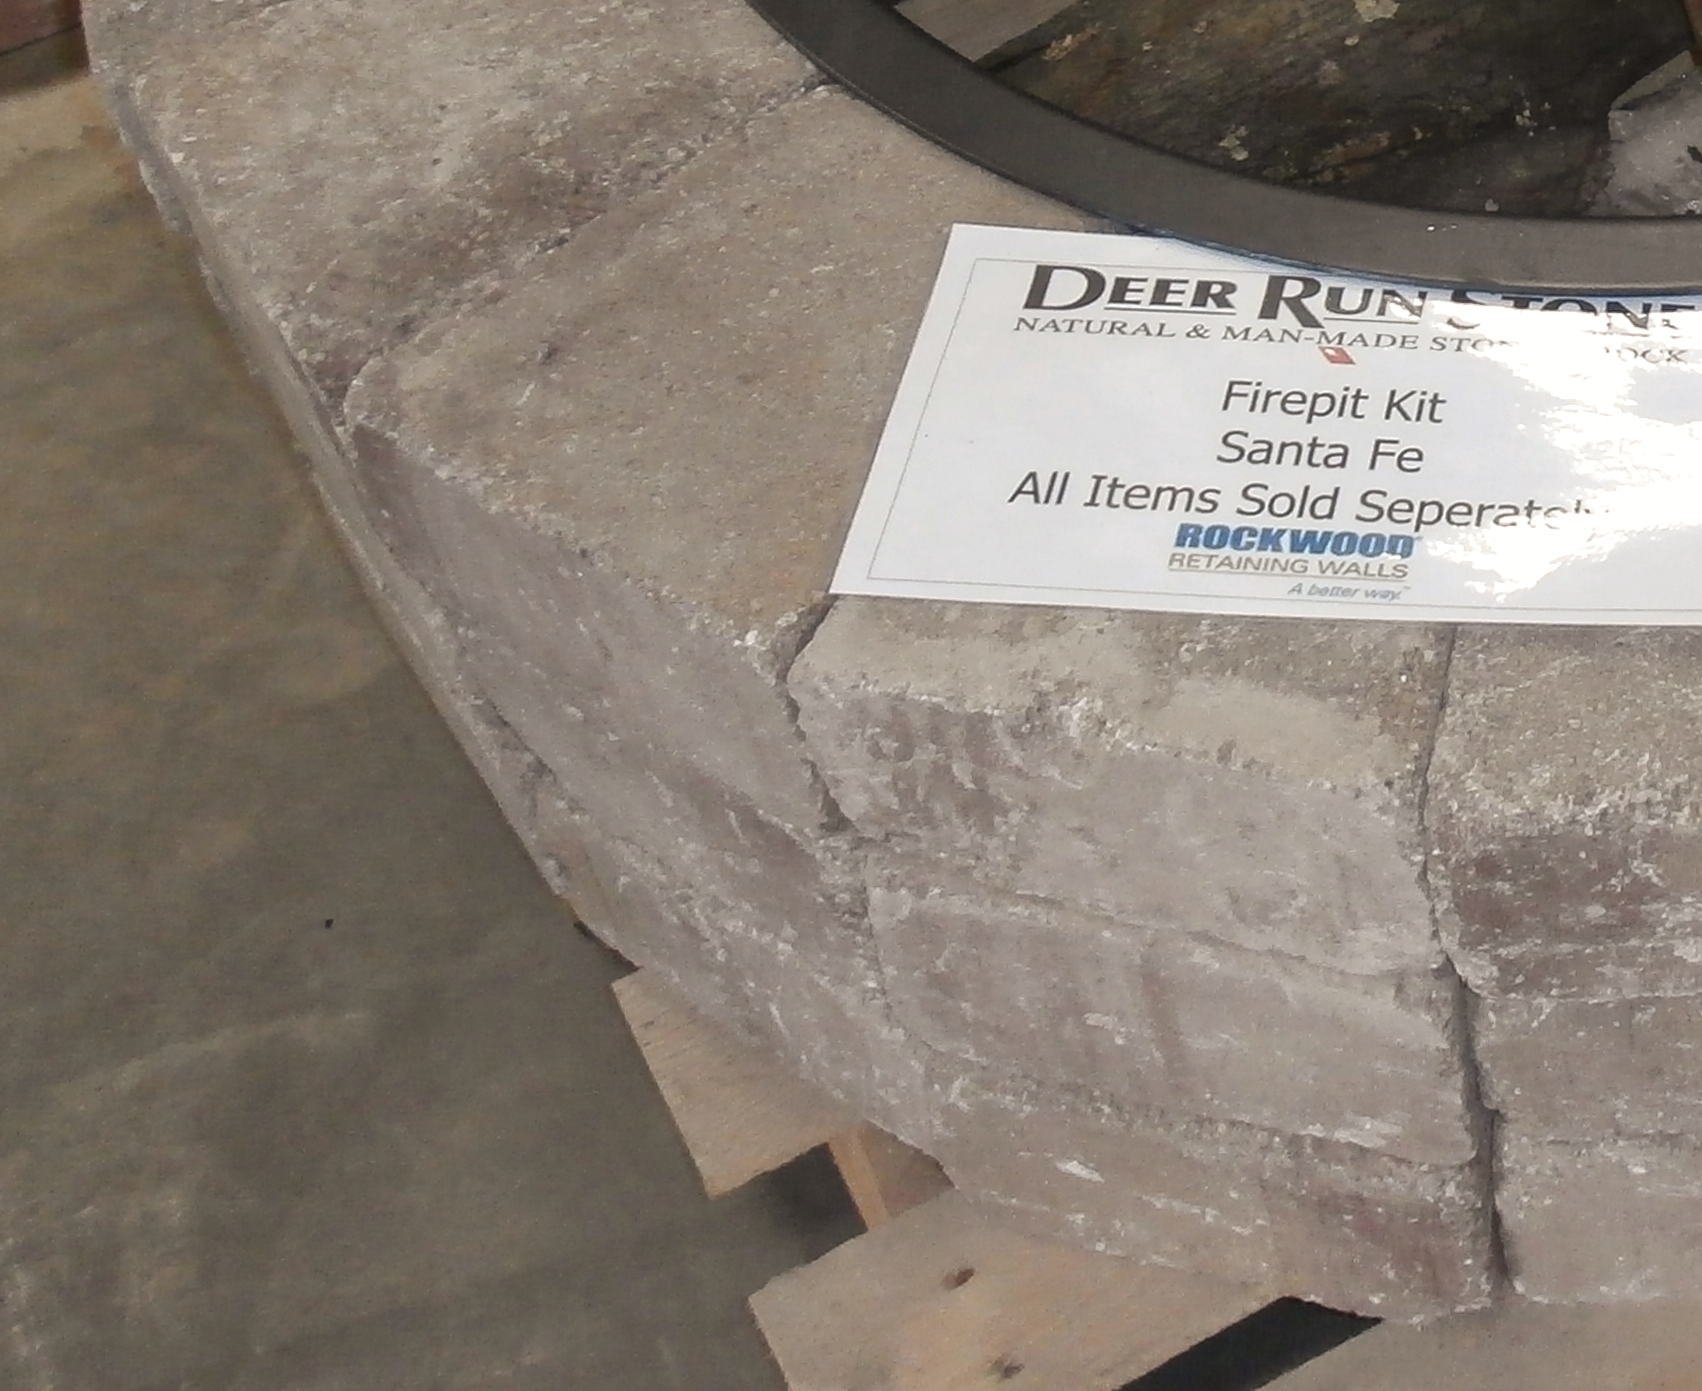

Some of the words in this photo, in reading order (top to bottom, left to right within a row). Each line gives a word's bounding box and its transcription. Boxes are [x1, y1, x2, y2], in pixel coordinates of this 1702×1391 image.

[1022, 264, 1238, 311] DEER
[1257, 275, 1428, 328] RUN
[1014, 317, 1176, 337] NATURAL
[1185, 324, 1211, 339] &
[1221, 325, 1419, 350] MAN-MADE
[1429, 336, 1522, 353] STO
[1603, 345, 1688, 364] OCK
[1222, 380, 1369, 424] Firepit
[1384, 389, 1447, 423] Kit
[1216, 430, 1350, 469] Santa
[1368, 438, 1424, 473] Fe
[1007, 471, 1071, 505] All
[1083, 474, 1221, 514] Items
[1236, 483, 1341, 520] Sold
[1355, 488, 1610, 534] Seperate
[1173, 522, 1416, 559] ROCKWOOD
[1168, 553, 1309, 575] RETAINING
[1318, 559, 1409, 578] WALLS
[1288, 583, 1303, 596] A
[1308, 584, 1359, 598] better
